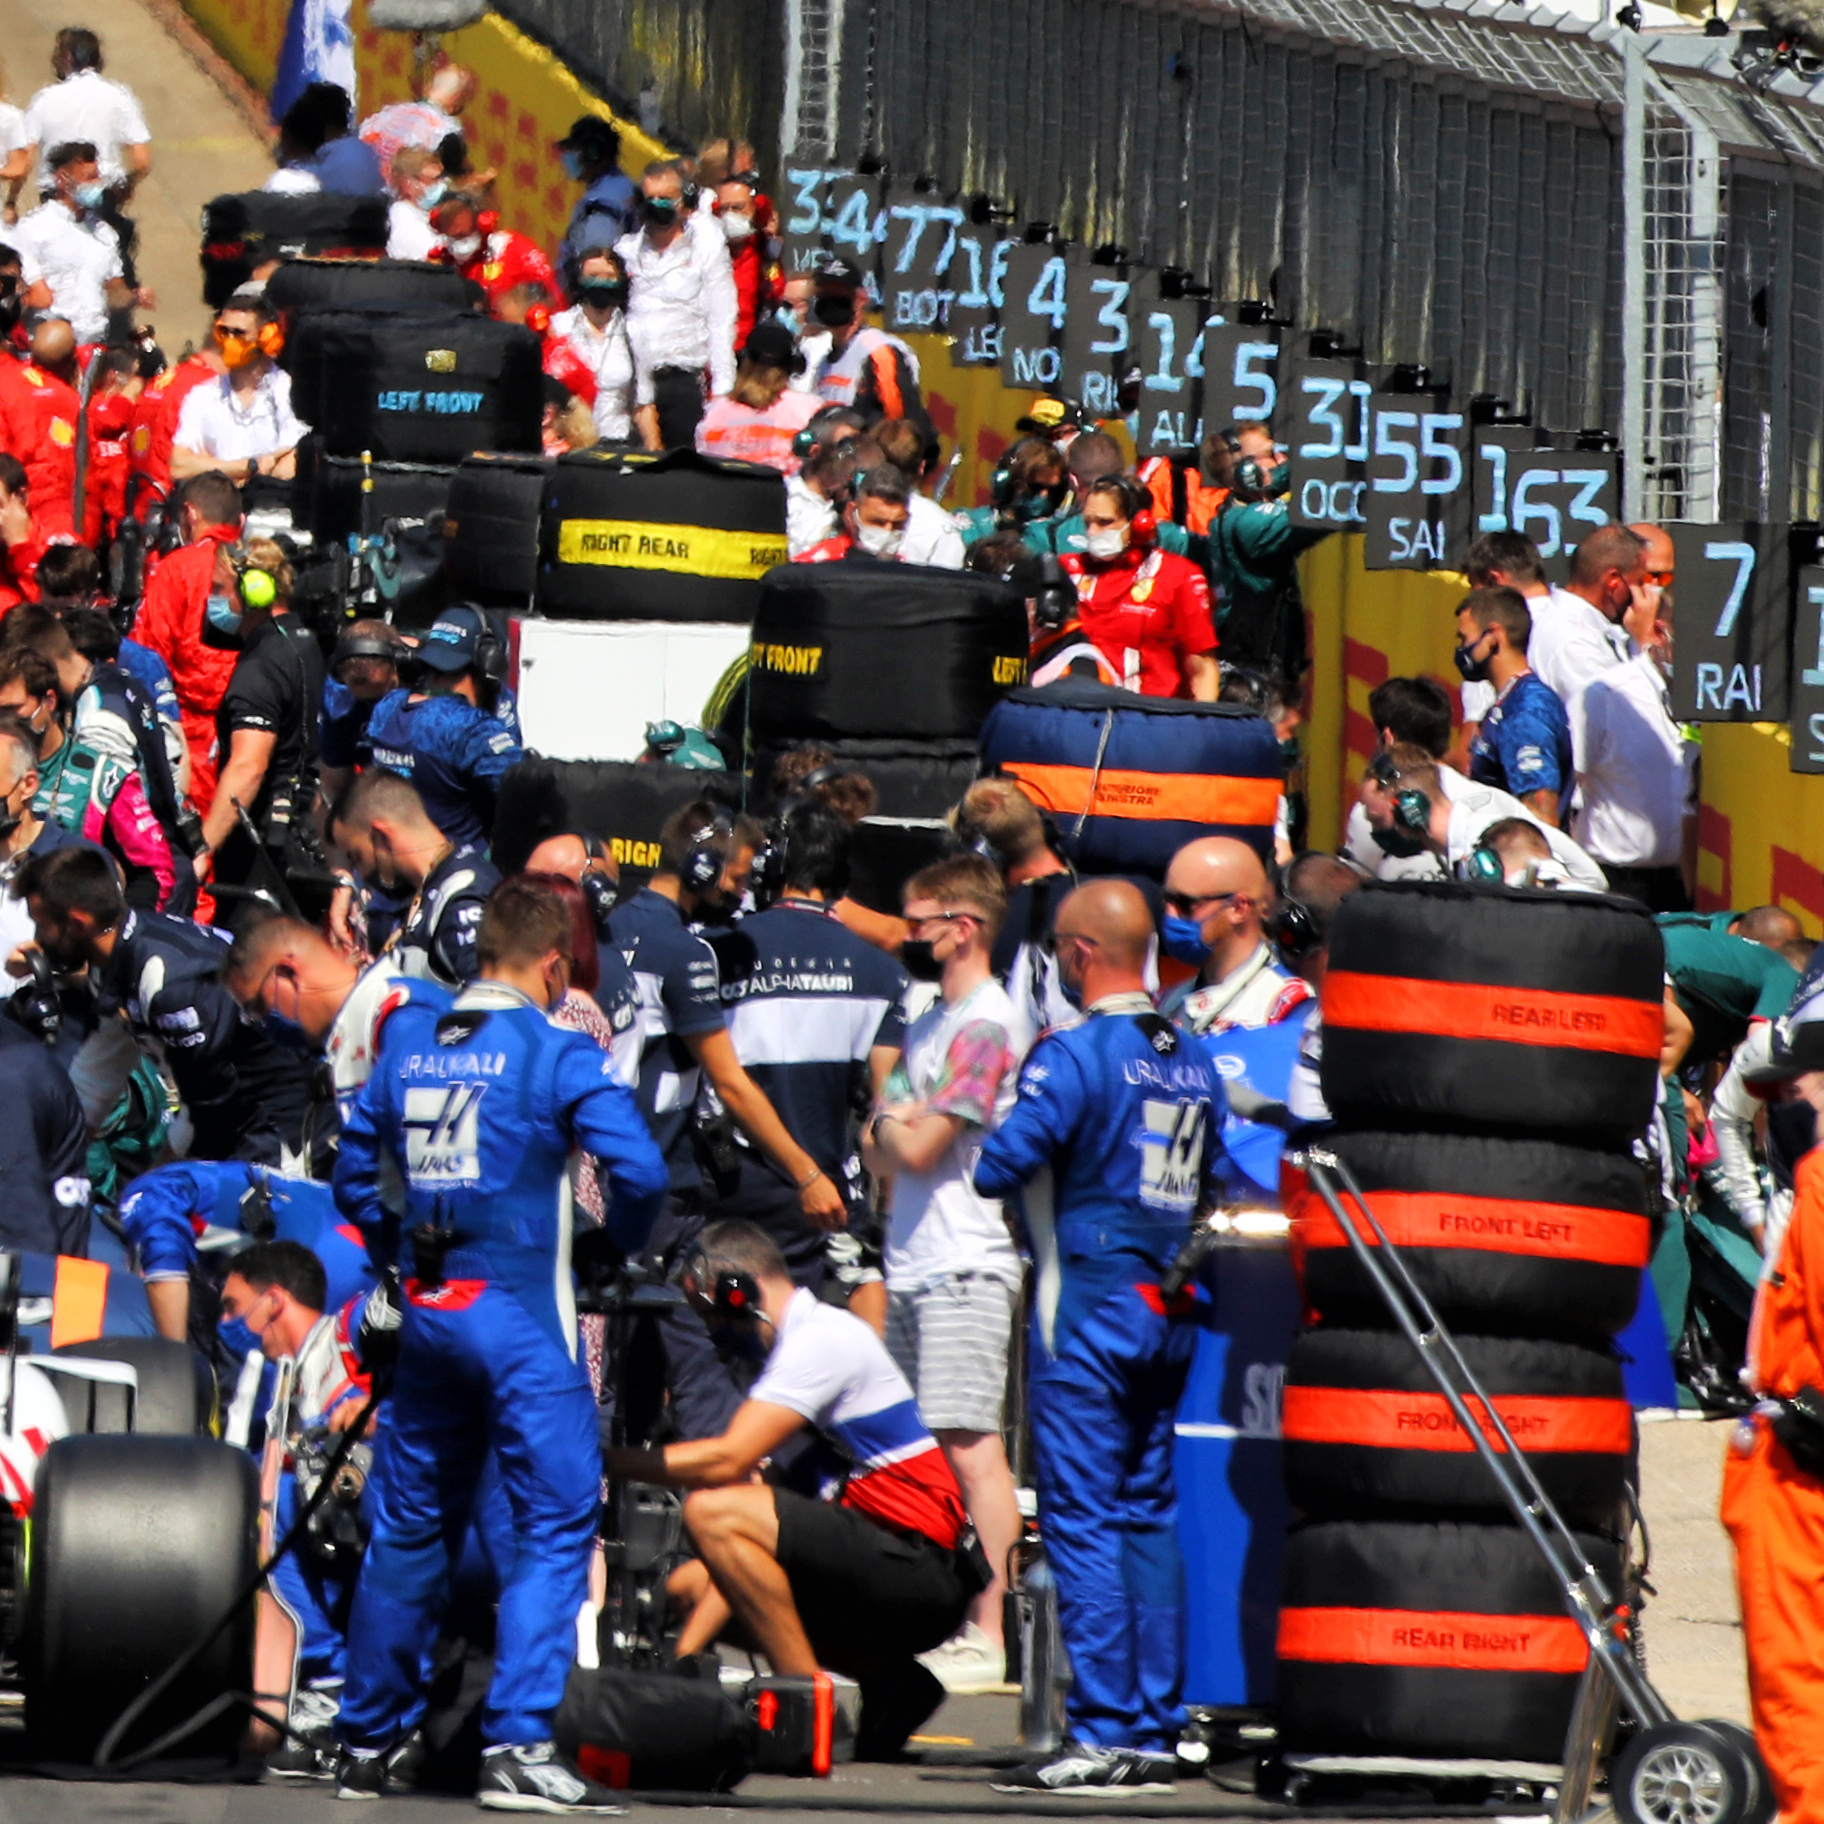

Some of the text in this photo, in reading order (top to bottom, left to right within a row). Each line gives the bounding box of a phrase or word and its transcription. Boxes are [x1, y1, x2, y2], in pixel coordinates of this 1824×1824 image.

[890, 204, 966, 274] 77
[895, 289, 956, 326] BOT
[1027, 255, 1067, 329] 4
[1087, 278, 1130, 354] 3
[1232, 341, 1279, 421] 5
[378, 389, 484, 416] LEFT FRONT
[1300, 375, 1372, 463] 31
[1373, 410, 1464, 495] 55
[1512, 468, 1610, 558] 63
[581, 532, 690, 560] RIGHT REAR
[1388, 517, 1446, 562] SAI
[1704, 542, 1756, 637] 7
[766, 644, 822, 675] FRONT
[1695, 662, 1762, 712] RAI
[611, 837, 662, 868] RIGH
[749, 973, 853, 995] ALPHATAURI
[1491, 1003, 1606, 1030] REAR LEFT
[398, 1050, 507, 1079] URALKALI
[1439, 1211, 1574, 1241] FRONT LEFT
[1393, 1626, 1531, 1652] REAR RIGHT
